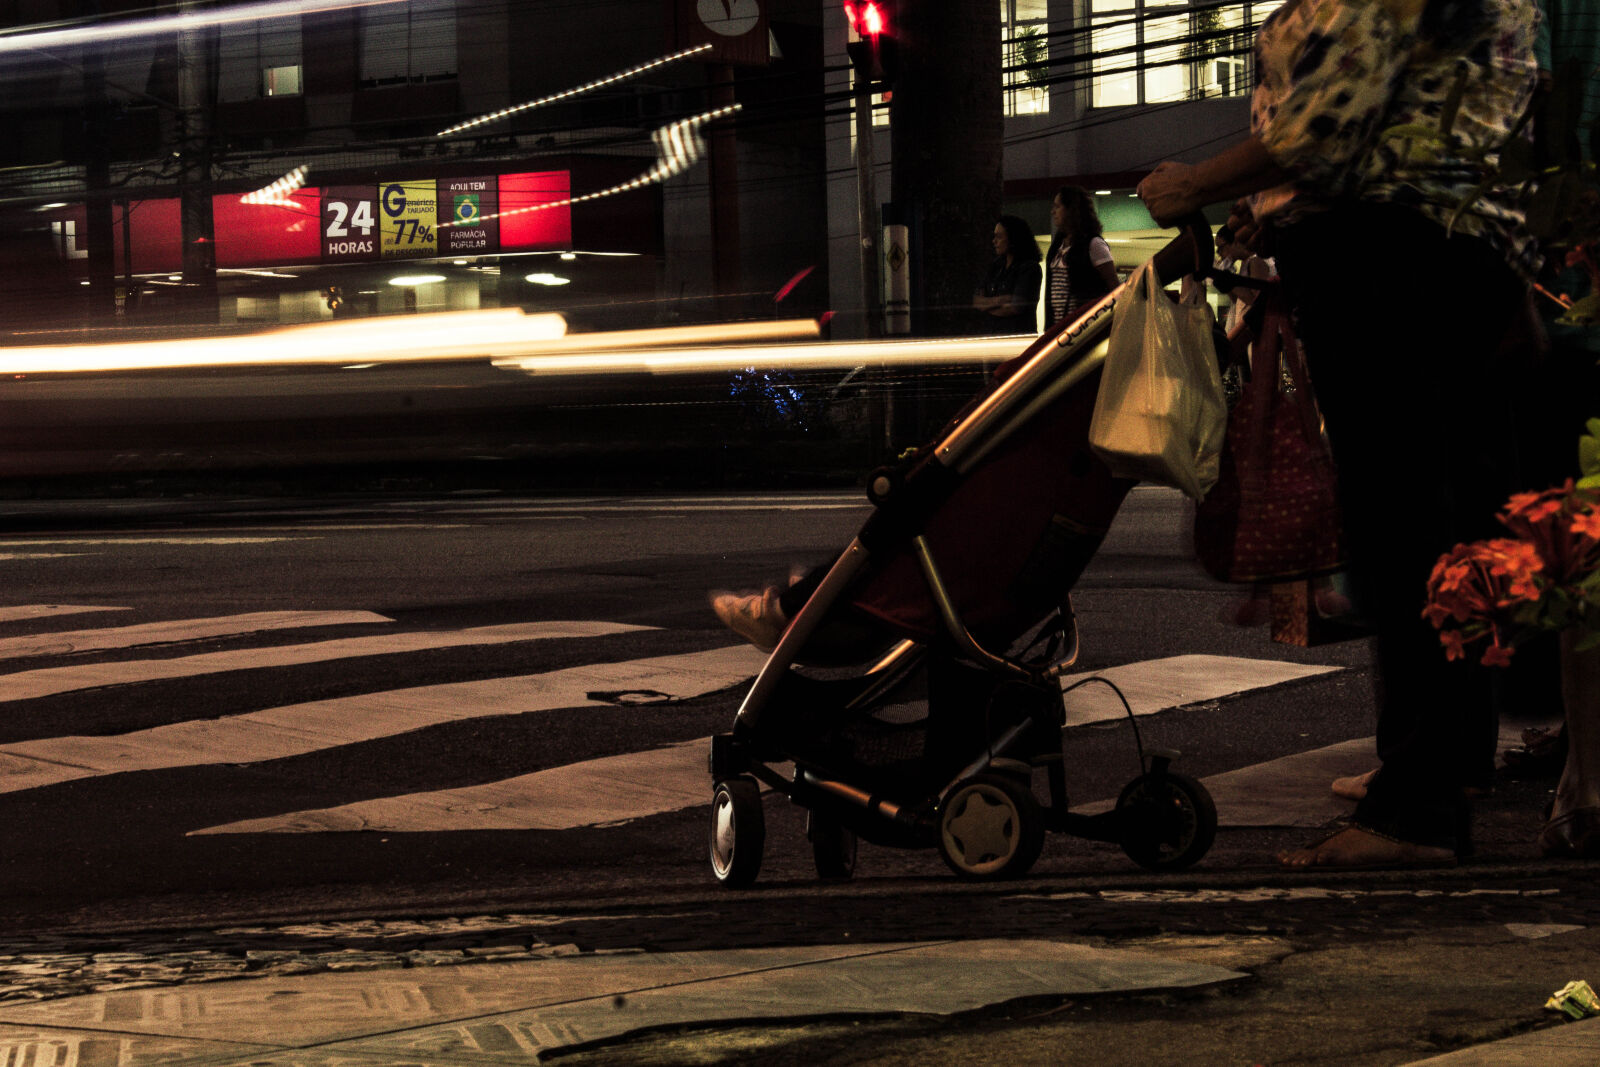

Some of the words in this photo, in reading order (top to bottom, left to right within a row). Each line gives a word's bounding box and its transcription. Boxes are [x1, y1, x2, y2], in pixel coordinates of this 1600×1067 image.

[469, 181, 486, 191] TEM
[326, 200, 374, 237] 24
[393, 219, 434, 244] 77%
[328, 241, 373, 255] HORAS
[396, 247, 434, 256] DESCONTO
[450, 240, 486, 249] POPULAR
[1057, 297, 1116, 347] Quinny
